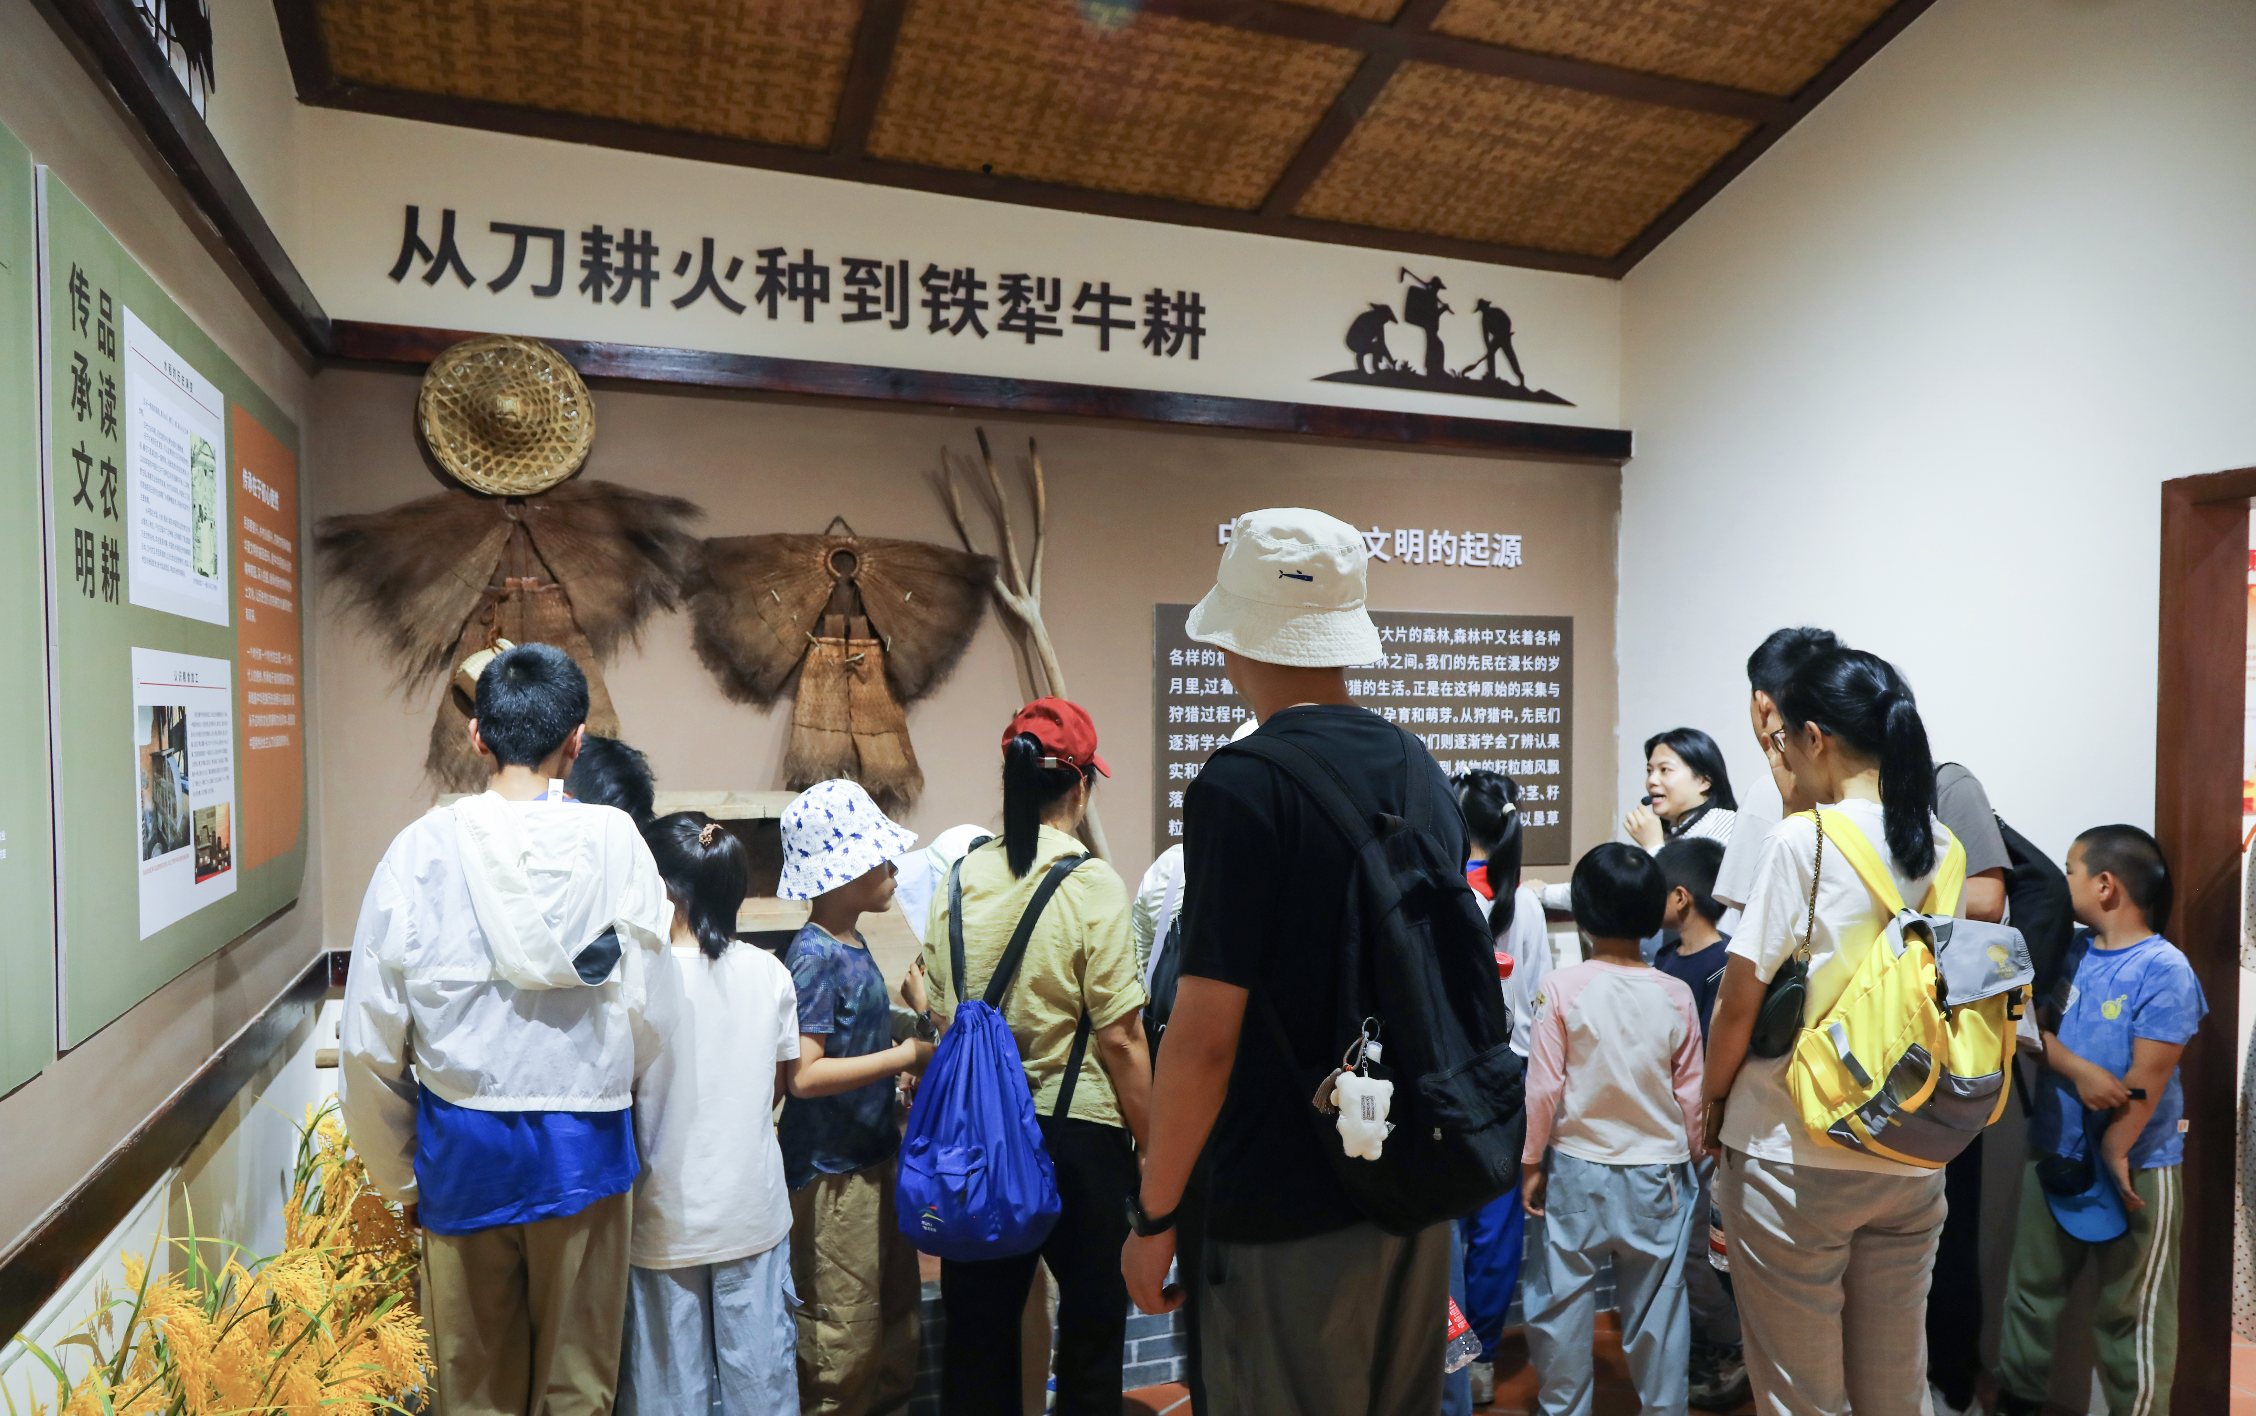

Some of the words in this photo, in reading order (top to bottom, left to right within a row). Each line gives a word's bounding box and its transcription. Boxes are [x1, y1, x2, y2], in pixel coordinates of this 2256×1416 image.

[387, 204, 1209, 361] 从刀耕火种到铁犁牛耕
[68, 261, 96, 600] 传承文明
[97, 287, 121, 606] 品读农耕
[1362, 526, 1523, 568] 文明的起源
[1374, 626, 1561, 646] 大片的森林,森林中又长着各种
[1348, 652, 1560, 672] 林之间。我们的先民在漫长的岁
[1345, 679, 1560, 698] 猎的生活。正是在这种原始的采集与
[1169, 706, 1257, 724] 狩猎过程中,
[1169, 762, 1206, 780] 实和
[1169, 791, 1183, 809] 落
[1169, 819, 1183, 836] 粒
